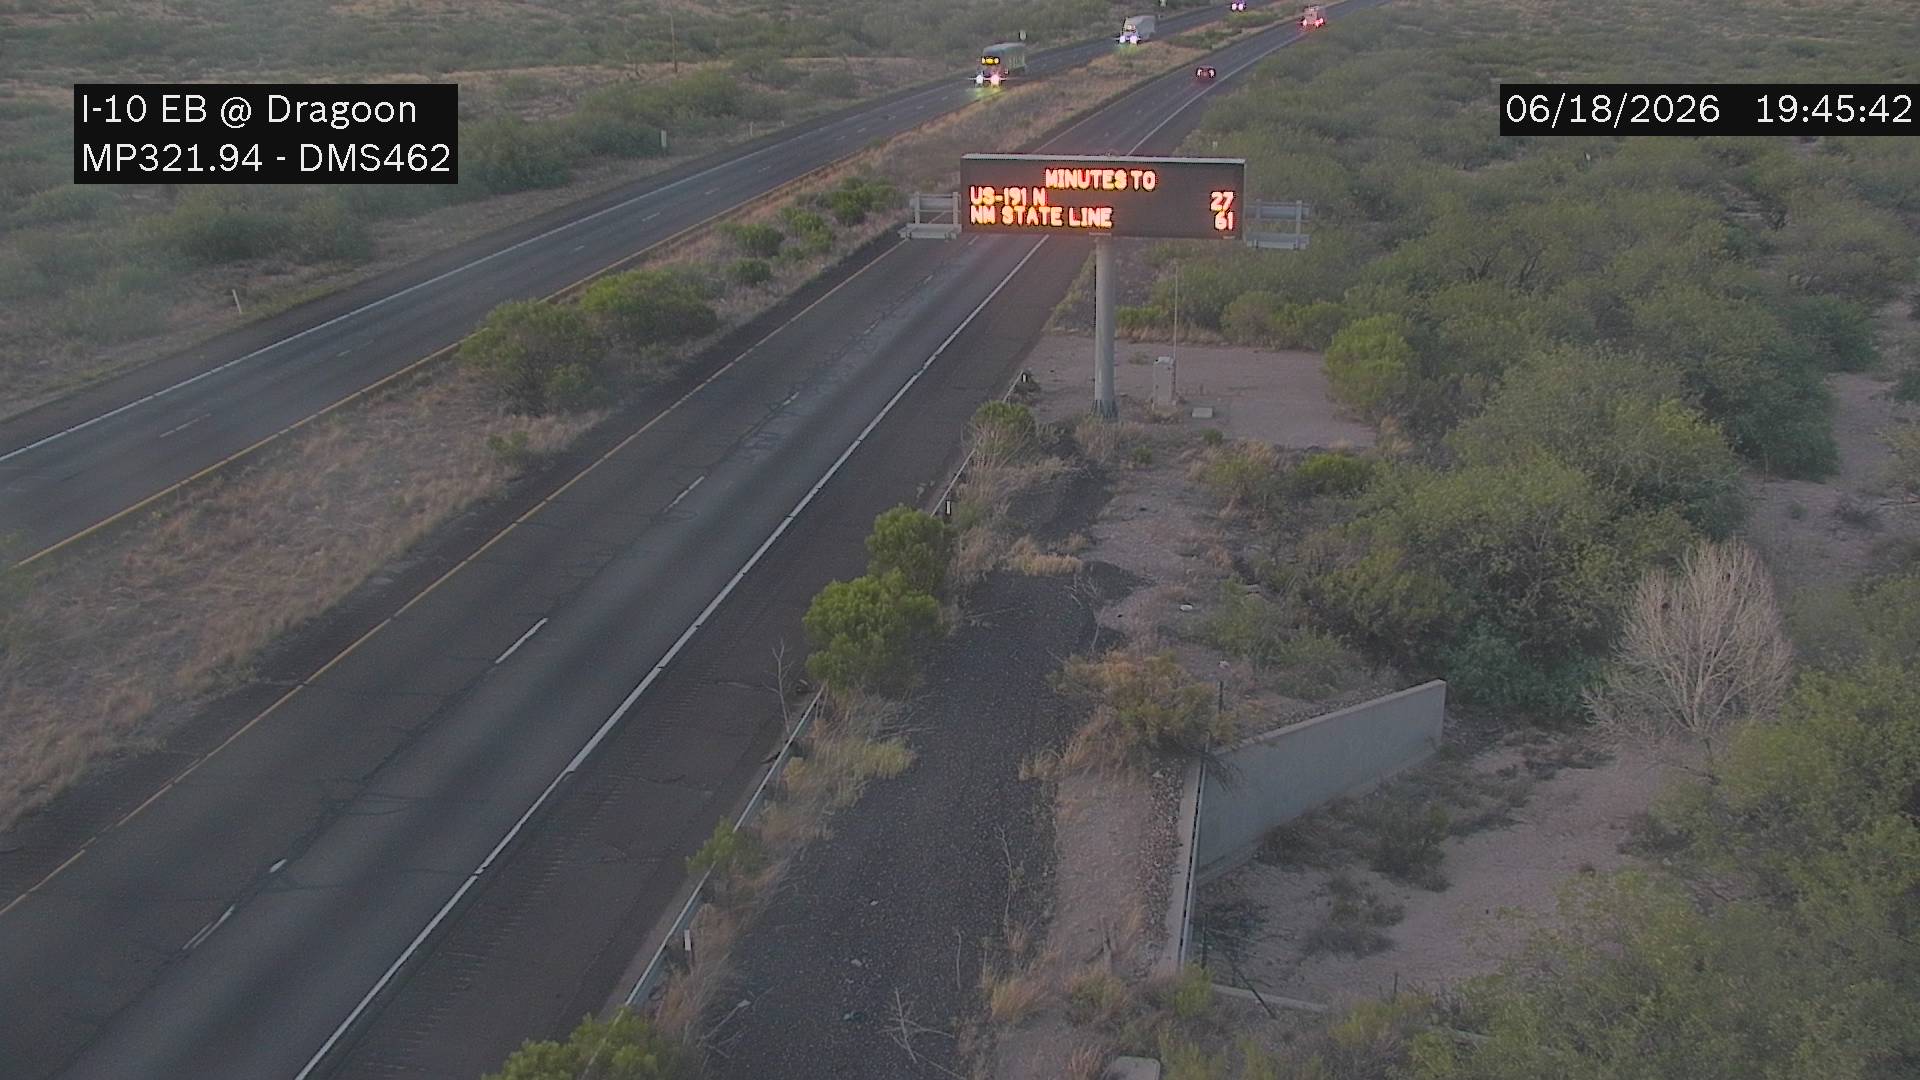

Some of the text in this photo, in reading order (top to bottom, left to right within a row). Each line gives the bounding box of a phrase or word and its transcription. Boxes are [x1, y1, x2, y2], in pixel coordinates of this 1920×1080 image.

[1045, 168, 1156, 190] MINUTES TO
[970, 186, 1047, 206] US-191 N
[1210, 191, 1235, 211] 27
[970, 206, 1113, 229] NM STATE LINE
[1213, 211, 1235, 231] 61
